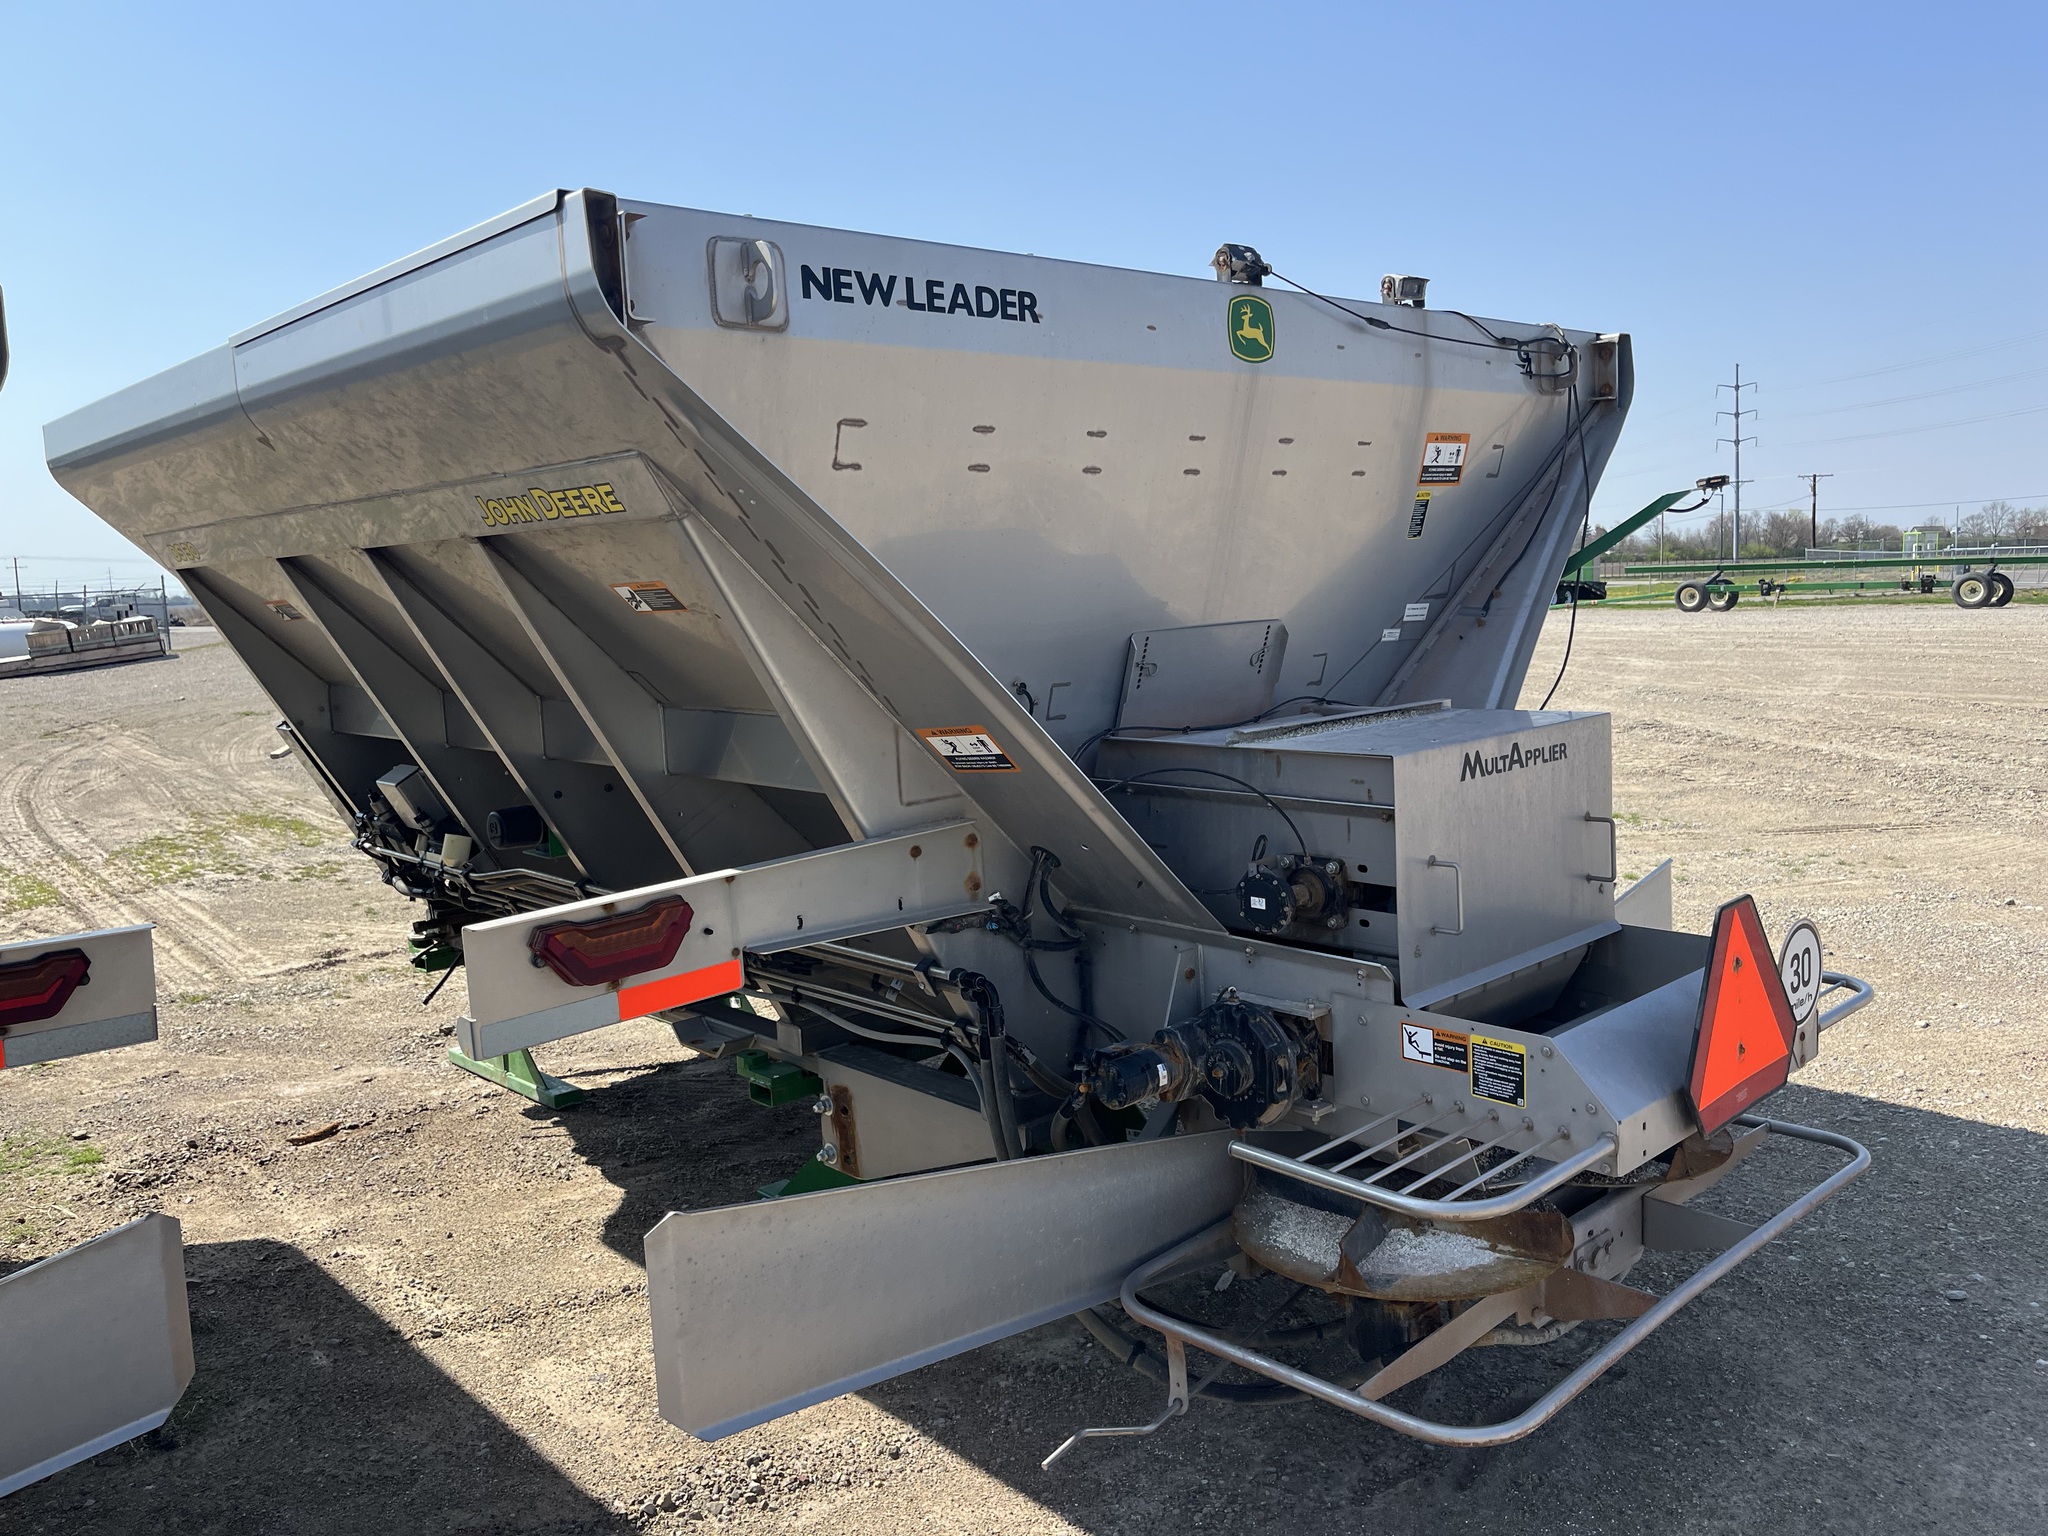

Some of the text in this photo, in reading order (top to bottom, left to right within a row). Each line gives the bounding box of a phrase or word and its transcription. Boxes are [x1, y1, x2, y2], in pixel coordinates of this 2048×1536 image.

[800, 264, 1040, 324] NEW LEADER
[475, 482, 627, 527] JOHN DEERE
[936, 727, 973, 735] WARNING
[1790, 946, 1811, 994] 30
[1441, 1032, 1467, 1042] WARNING
[1489, 1040, 1513, 1050] CAUTION
